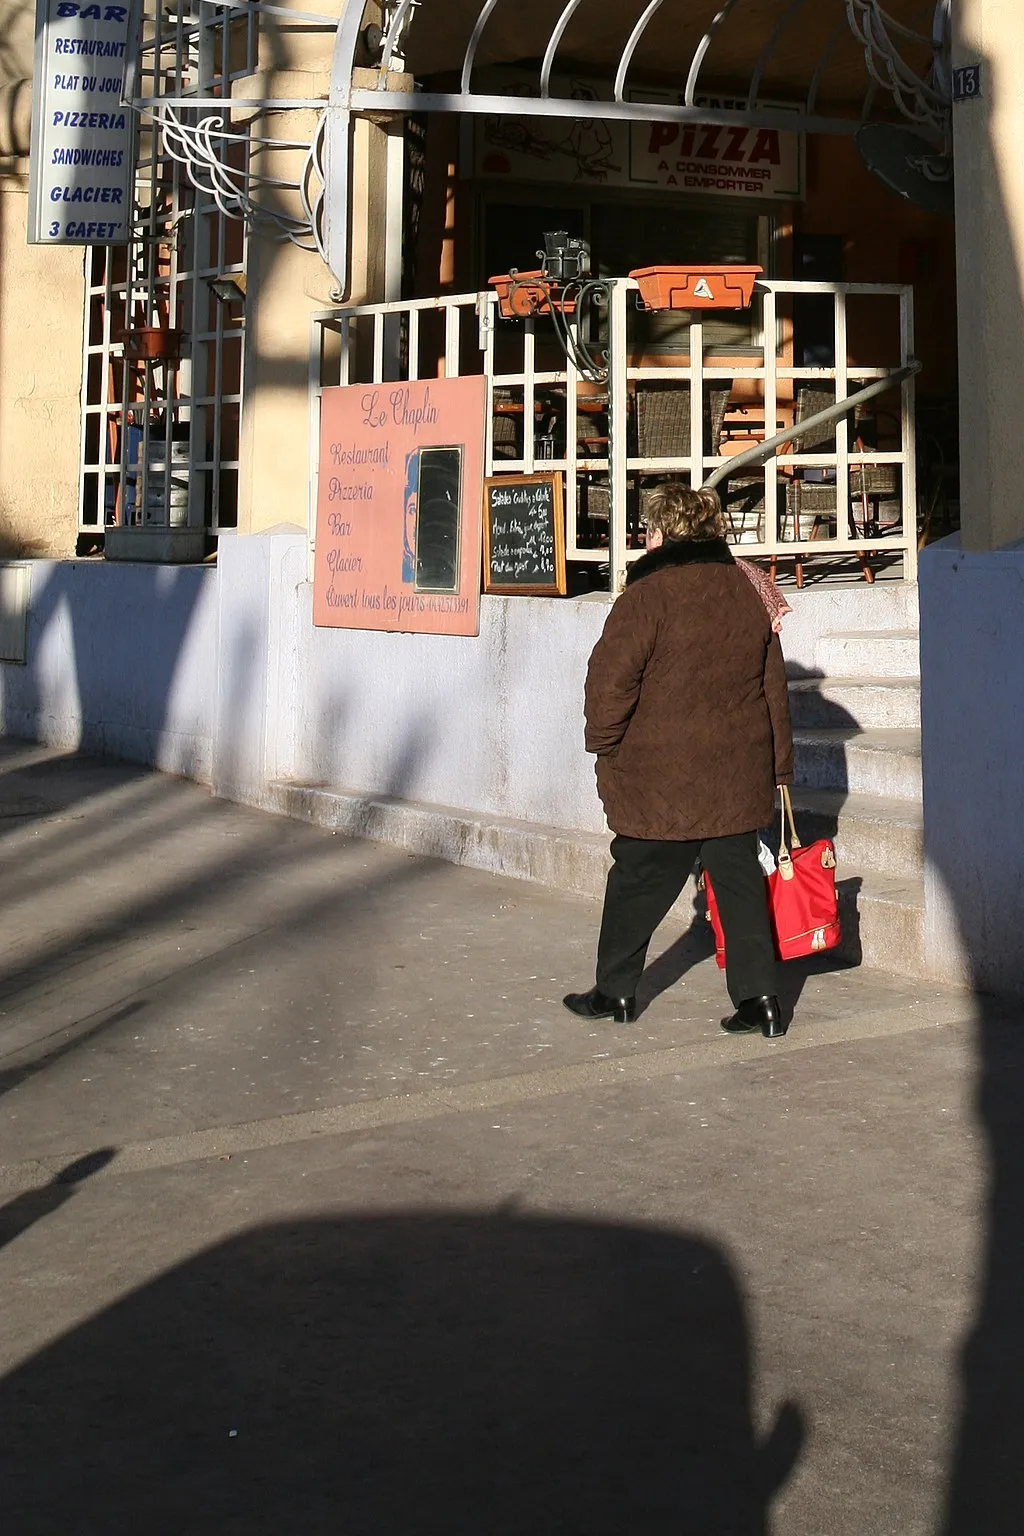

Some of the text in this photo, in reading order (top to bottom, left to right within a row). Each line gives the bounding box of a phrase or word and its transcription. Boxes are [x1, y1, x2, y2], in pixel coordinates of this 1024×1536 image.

[56, 2, 128, 22] BAR
[55, 38, 126, 58] RESTAURANT
[54, 74, 79, 91] PLAT
[82, 75, 97, 92] DU
[957, 69, 976, 94] 13
[53, 111, 125, 130] PIZZERIA
[52, 148, 124, 167] SANDWICHES
[657, 160, 771, 179] A CONSOMMER
[667, 175, 763, 192] A EMPORTER
[50, 186, 123, 204] GLACIER
[49, 221, 60, 237] 3
[361, 386, 439, 434] Le Chaplin
[330, 440, 391, 466] Restaurant
[328, 477, 373, 501] Pizzeria
[328, 513, 352, 537] Bar
[327, 549, 363, 583] Glacier
[326, 585, 359, 608] Ouvert
[362, 589, 381, 609] tous
[383, 585, 397, 610] les
[397, 592, 425, 622] jours
